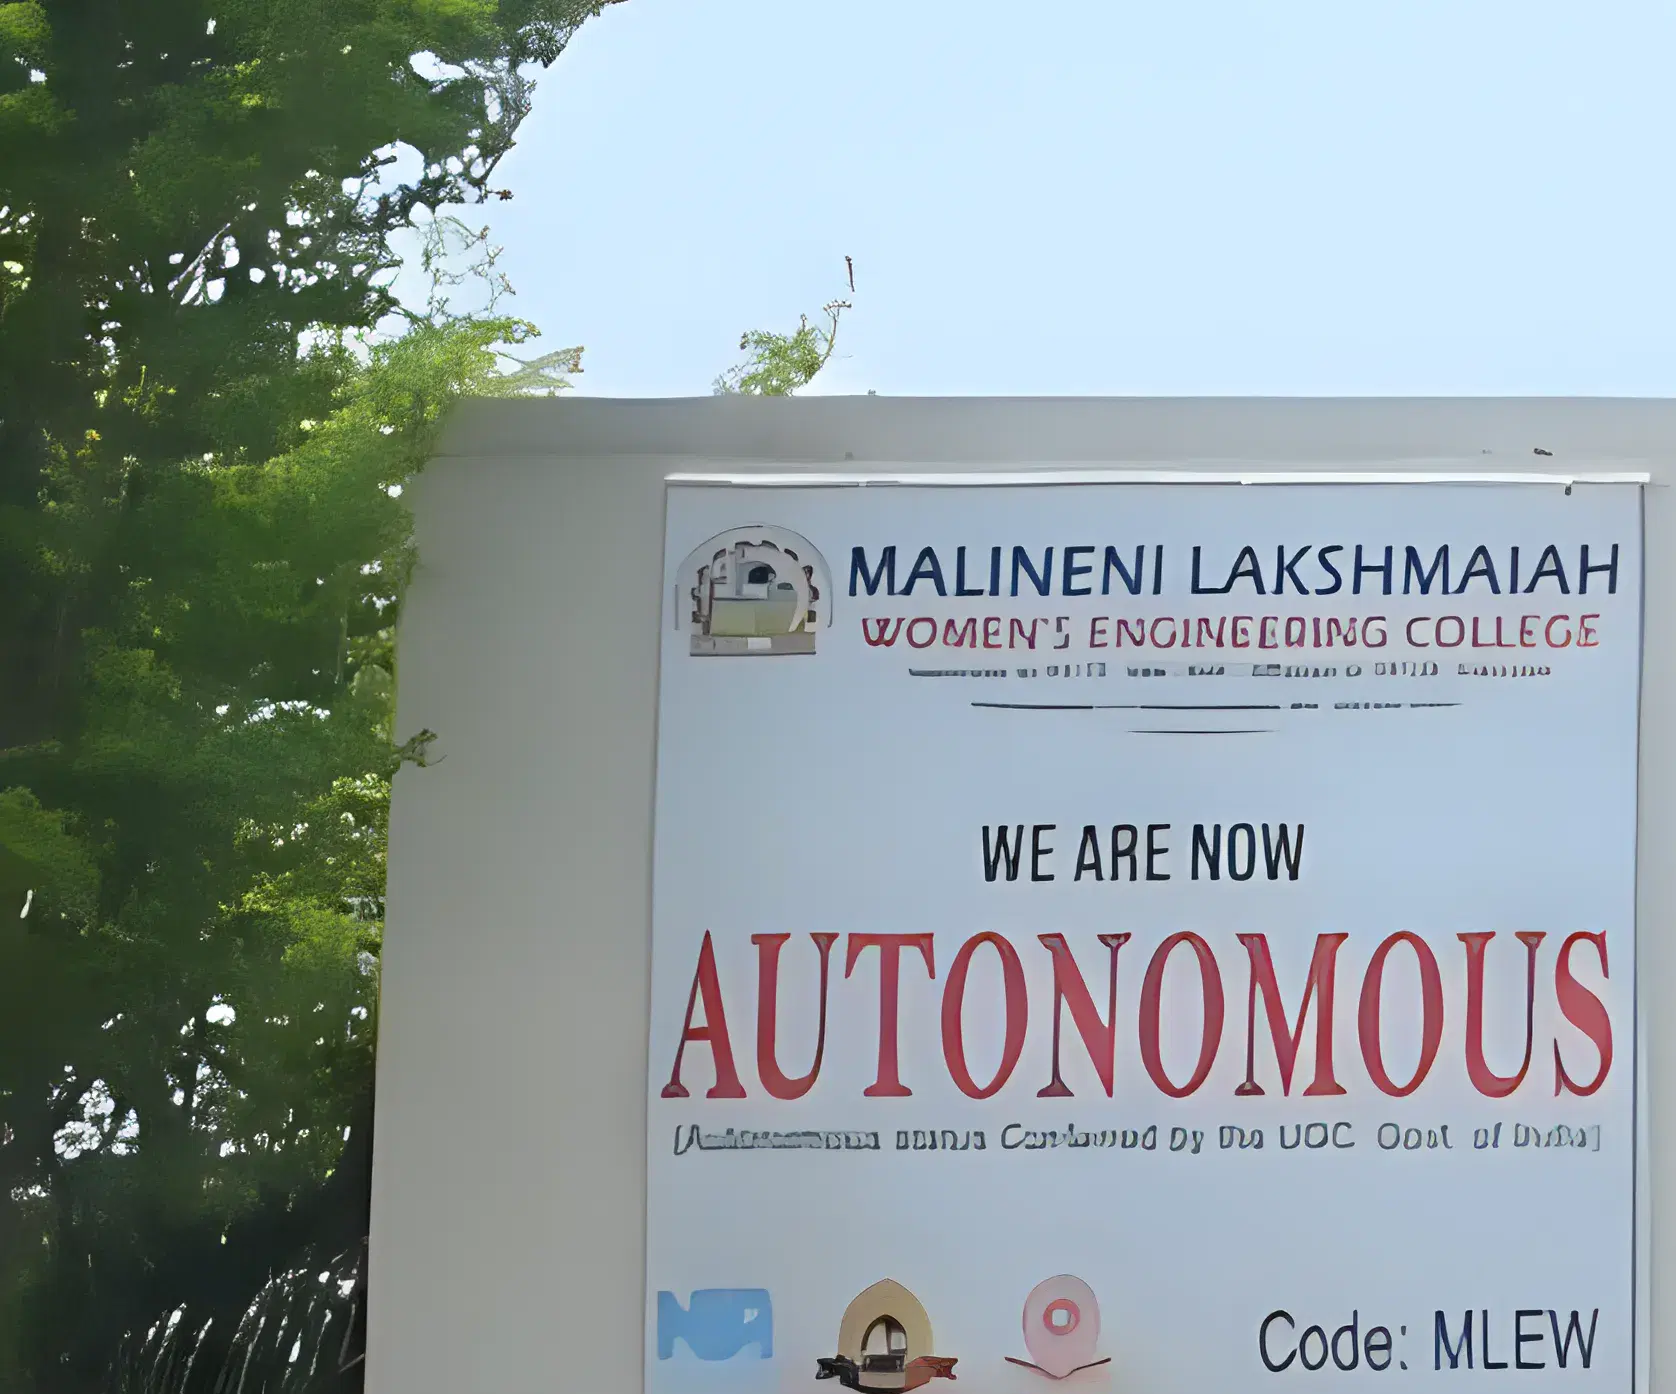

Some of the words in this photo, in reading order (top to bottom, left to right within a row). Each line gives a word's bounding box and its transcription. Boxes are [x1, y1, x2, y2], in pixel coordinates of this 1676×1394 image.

[849, 544, 1163, 597] MALINENI
[1191, 543, 1619, 596] LAKSHMAIAH
[1406, 614, 1601, 649] COLLEGE
[982, 824, 1056, 882] WE
[1074, 824, 1170, 881] ARE
[1191, 823, 1304, 881] NOW
[661, 929, 1614, 1101] AUTONOMOUS
[1258, 1309, 1408, 1373] Code:
[1434, 1307, 1600, 1370] MLEW
